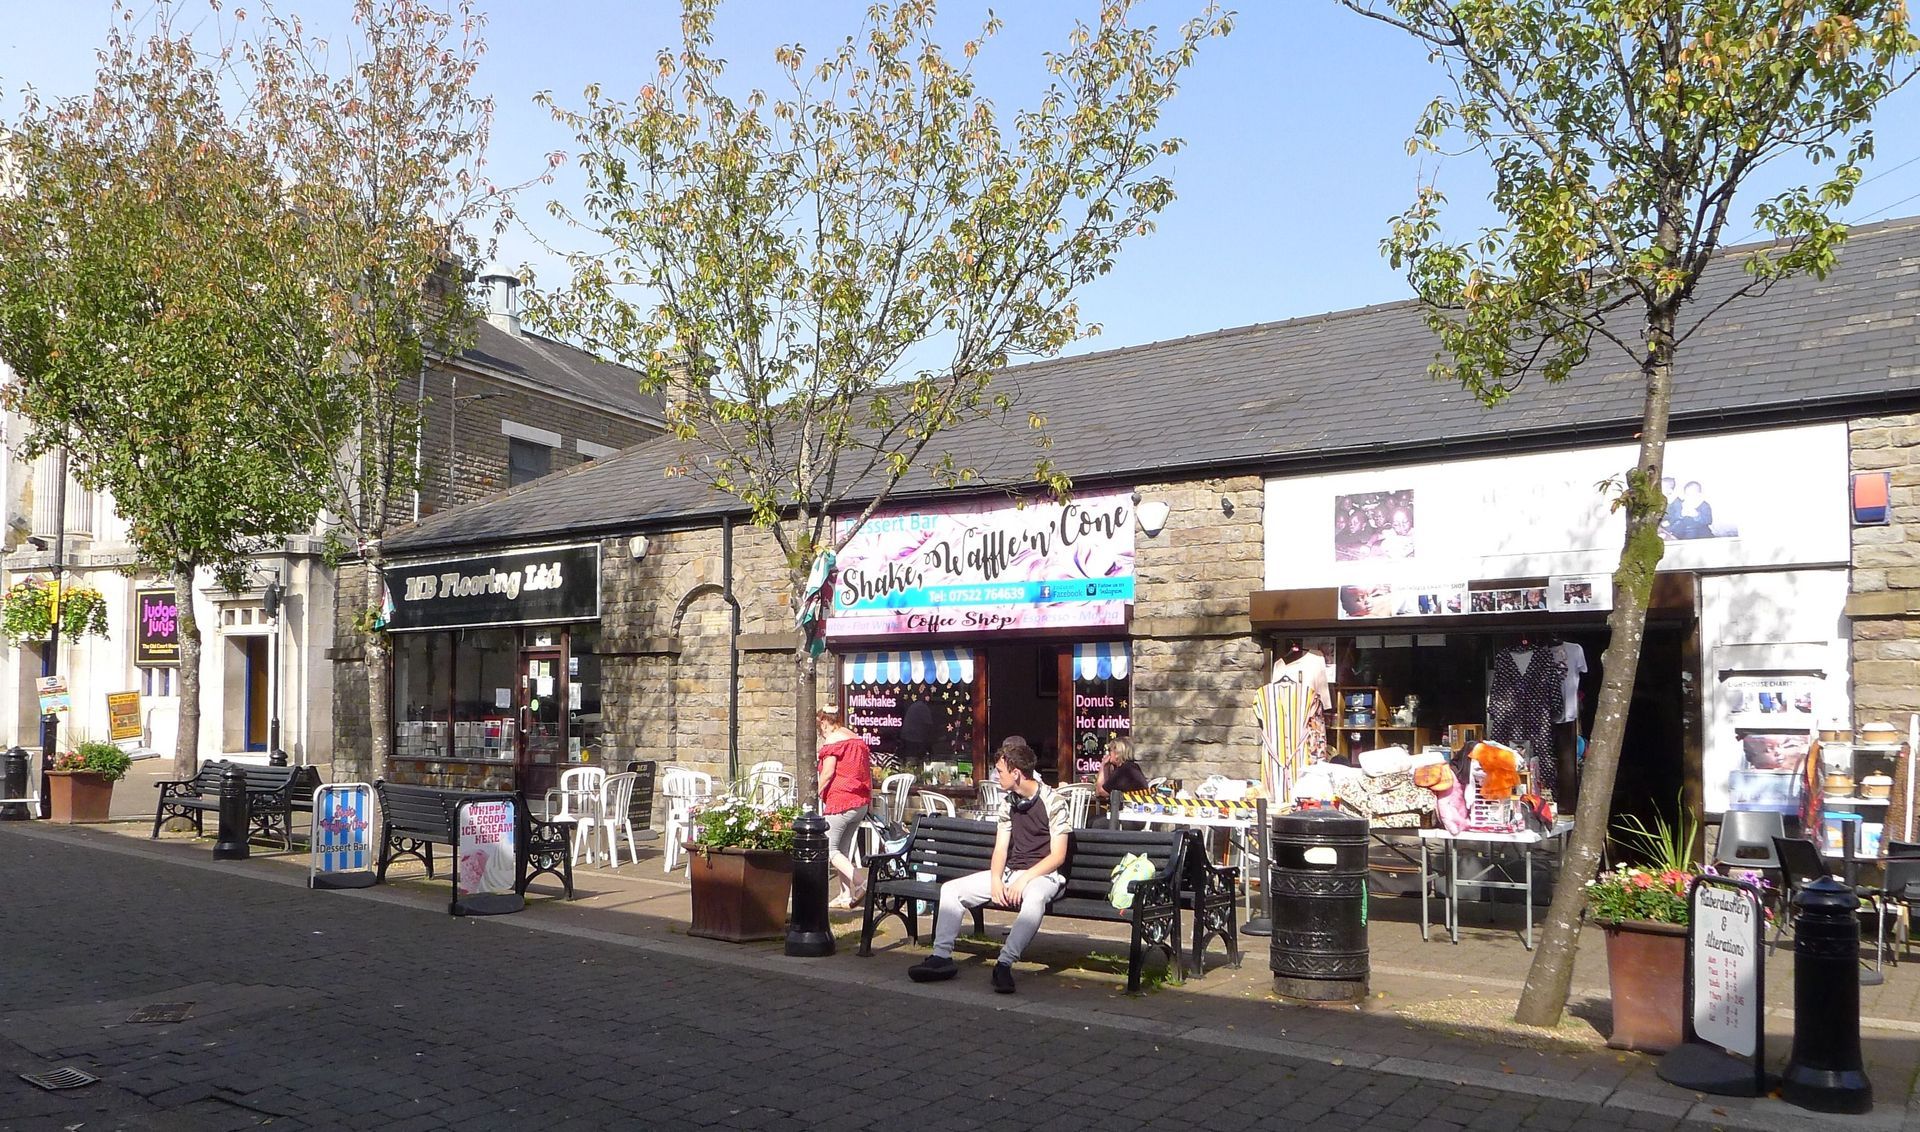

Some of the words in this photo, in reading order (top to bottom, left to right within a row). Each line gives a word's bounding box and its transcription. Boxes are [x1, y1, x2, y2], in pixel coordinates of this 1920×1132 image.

[910, 512, 938, 530] Bar
[840, 561, 923, 606] Shake,
[923, 526, 1021, 581] Waffle
[1060, 504, 1129, 546] Cone
[439, 567, 522, 600] Flooring
[523, 562, 563, 592] Ltd
[928, 590, 947, 602] Tel:
[949, 588, 982, 601] 07522
[984, 587, 1025, 600] 764639
[1053, 590, 1083, 598] Facebook
[907, 612, 957, 633] Coffee
[961, 611, 1017, 630] Shop
[849, 694, 897, 708] Milkshakes
[1076, 694, 1115, 708] Donuts
[849, 713, 903, 727] Cheesecakes
[1076, 715, 1096, 729] Hot
[1097, 714, 1131, 729] drinks
[469, 805, 507, 816] WHIPPY
[477, 815, 506, 825] SCOOP
[462, 826, 477, 836] ICE
[480, 823, 513, 834] CREAM
[475, 834, 500, 844] HERE
[320, 843, 351, 853] Dessert
[353, 842, 367, 851] Bar
[1700, 889, 1750, 923] Haberdashery
[1721, 916, 1728, 931] &
[1704, 930, 1745, 957] Alterations
